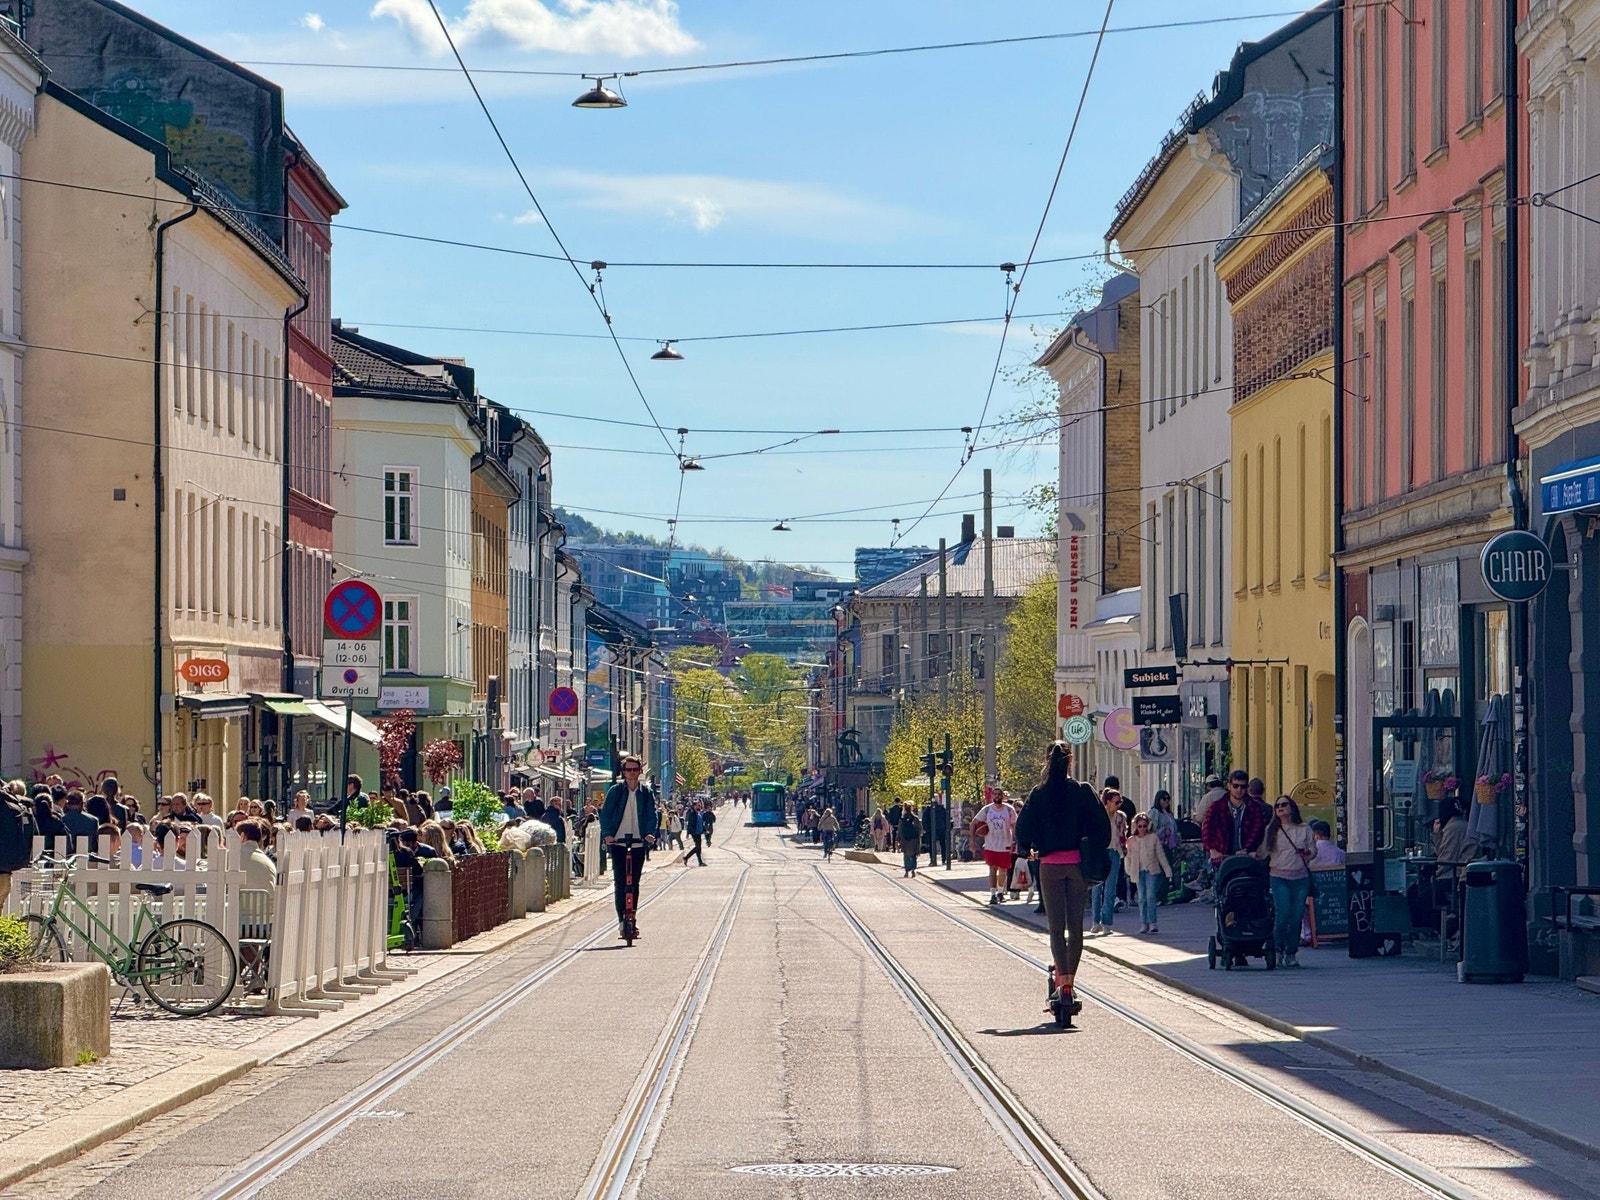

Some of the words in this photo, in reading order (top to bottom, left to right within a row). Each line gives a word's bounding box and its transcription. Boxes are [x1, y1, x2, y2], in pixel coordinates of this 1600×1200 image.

[1070, 535, 1079, 593] EVENSEN
[1489, 549, 1546, 582] CHAIR
[1069, 598, 1078, 630] JENS
[335, 654, 367, 663] (12-06)
[188, 665, 222, 677] DIGG
[1132, 672, 1170, 682] Subjekt
[331, 686, 354, 695] Øvrig
[357, 686, 369, 695] tid
[1071, 723, 1084, 735] life
[544, 748, 560, 756] elna
